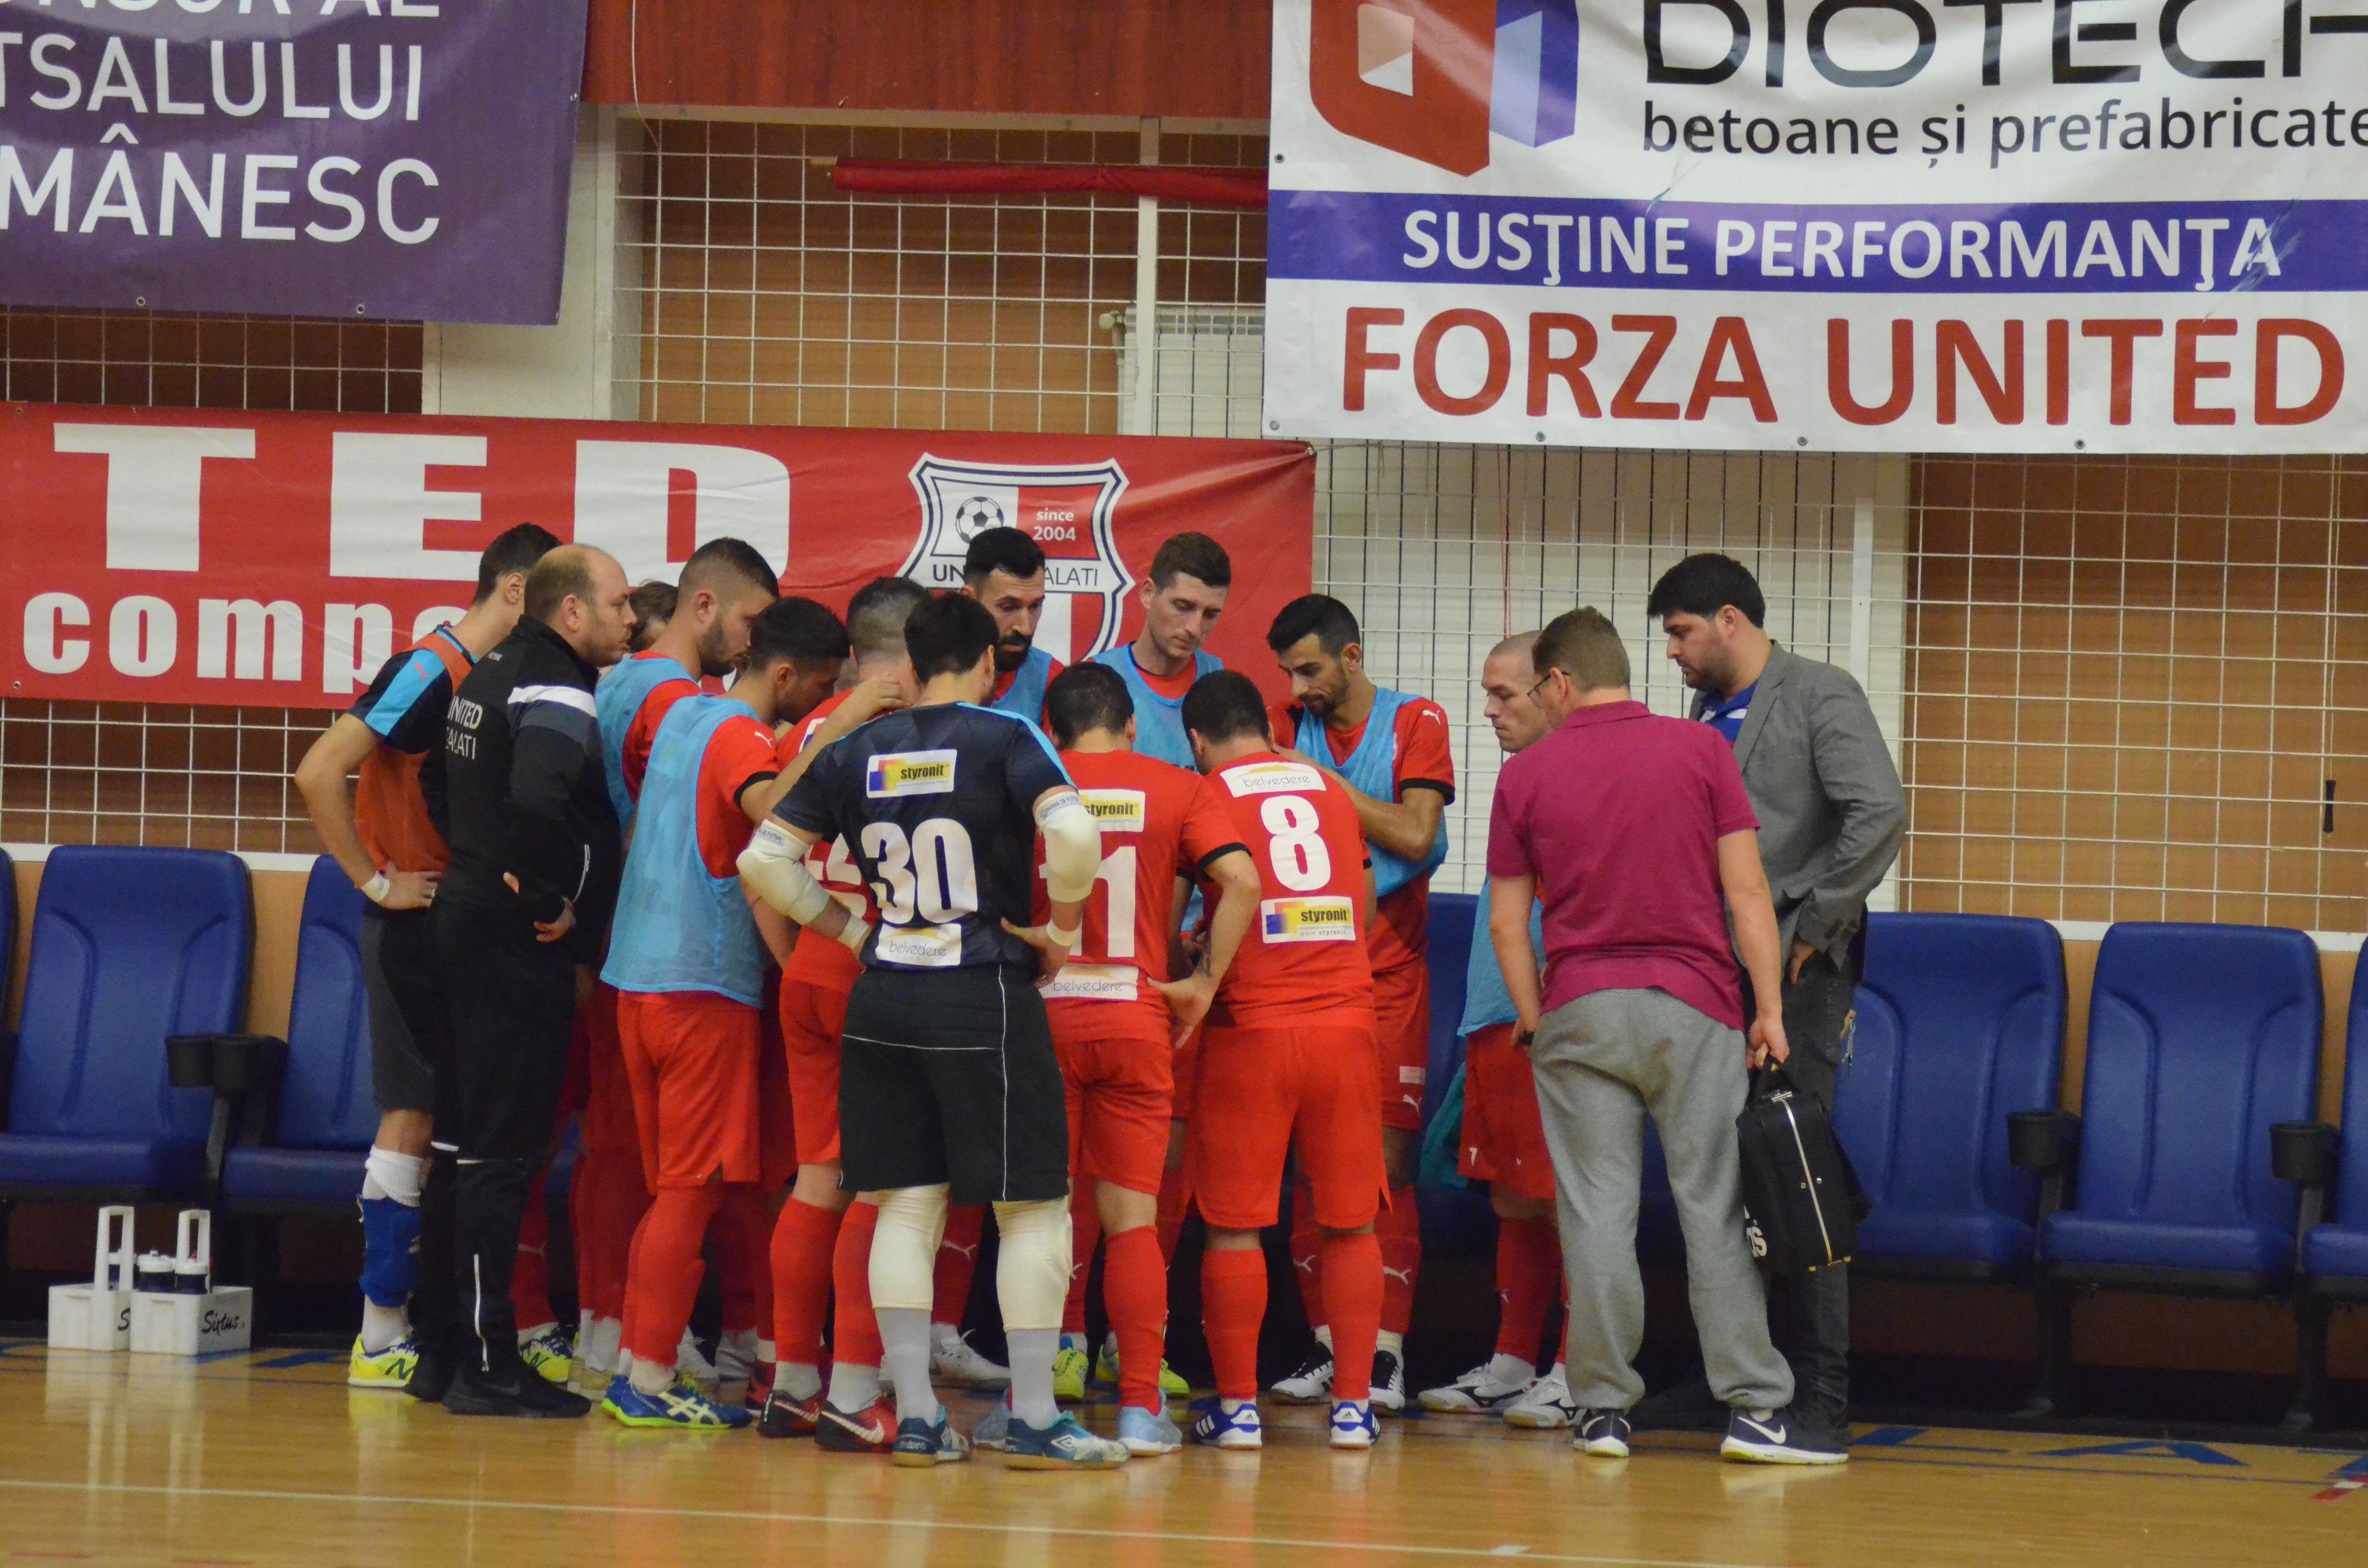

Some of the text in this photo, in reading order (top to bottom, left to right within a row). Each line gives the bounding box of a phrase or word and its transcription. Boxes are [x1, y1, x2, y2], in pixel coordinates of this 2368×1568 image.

[1643, 101, 1898, 154] betoane
[1991, 98, 2368, 169] prefabricate
[0, 123, 439, 244] MÂNESC
[1343, 306, 2344, 425] FORZA UNITED
[54, 422, 790, 588] TED
[1036, 508, 1074, 522] since
[1033, 527, 1076, 541] 2004
[1045, 567, 1098, 586] ALATI
[900, 764, 944, 779] styronit
[1242, 775, 1310, 786] belvedere
[1084, 803, 1134, 817] styronit
[1261, 795, 1331, 891] 8
[861, 818, 978, 924] 30
[1301, 908, 1347, 922] styronit
[890, 940, 946, 956] belvedere
[1054, 980, 1122, 991] belvedere
